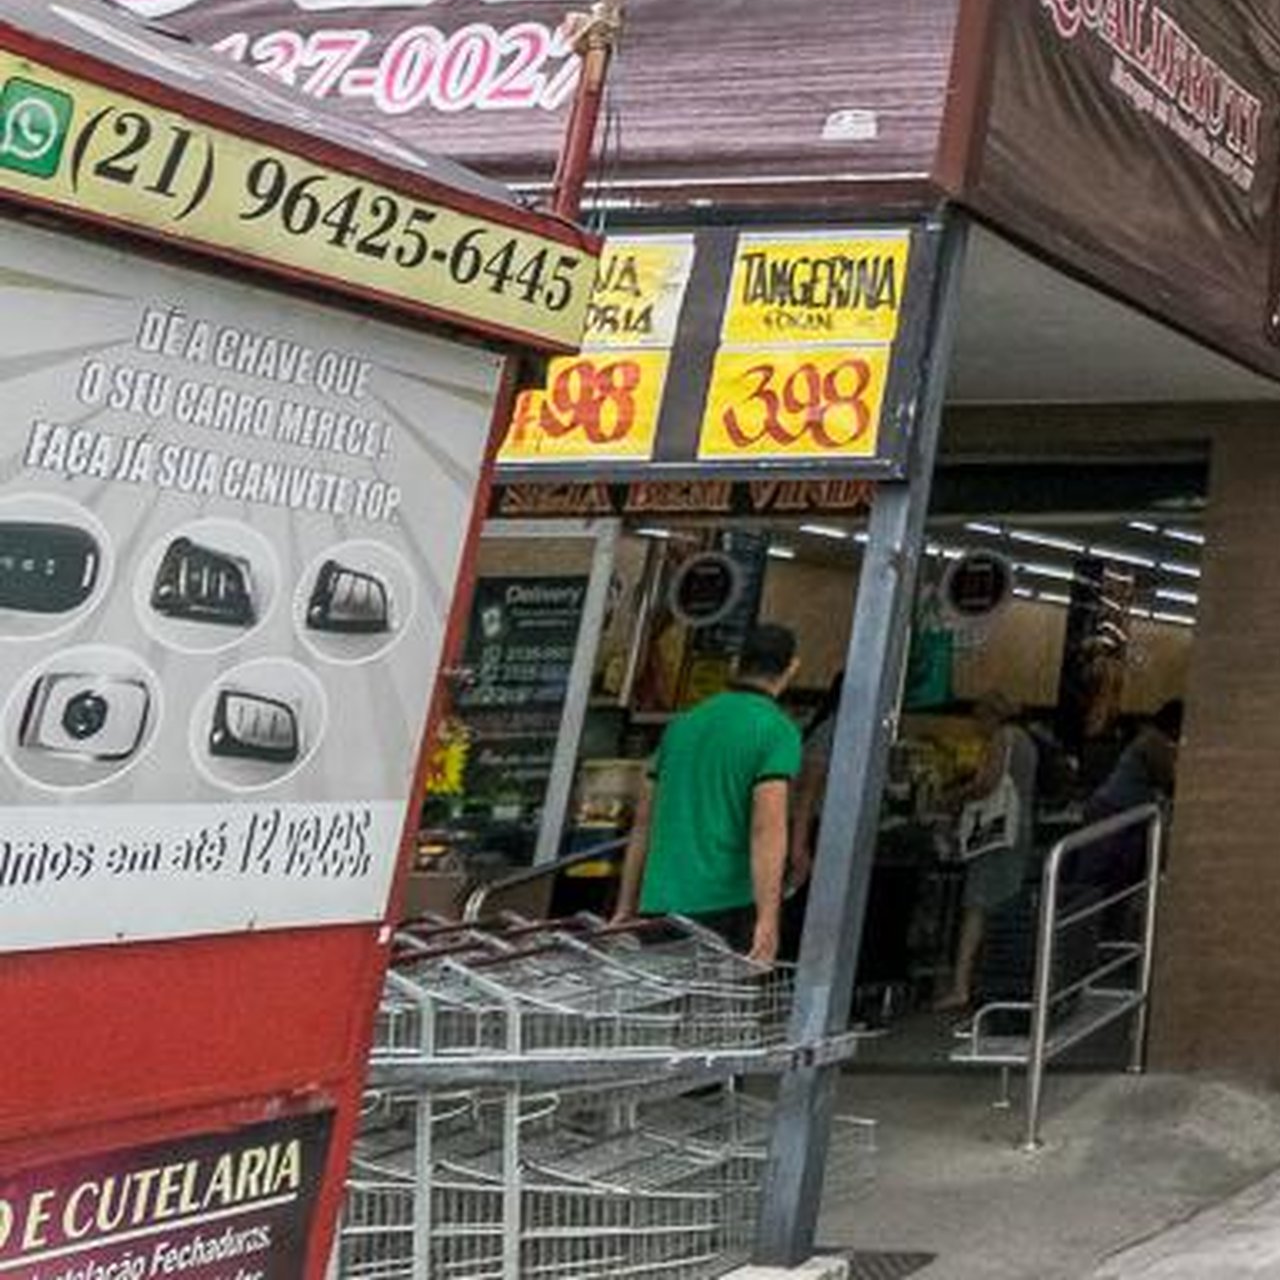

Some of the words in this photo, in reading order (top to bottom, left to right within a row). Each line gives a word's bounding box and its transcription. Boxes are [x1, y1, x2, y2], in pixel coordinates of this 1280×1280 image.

[69, 104, 216, 220] (21)
[239, 159, 580, 312] 96425-6445
[740, 253, 897, 311] TANGERINA
[214, 326, 313, 385] CHAVE
[313, 351, 373, 399] QUE
[106, 366, 172, 419] SEU
[173, 380, 276, 437] CARRO
[155, 444, 219, 496] SUA
[62, 1137, 301, 1239] CUTELARIA
[150, 1224, 271, 1276] Fechaduras
